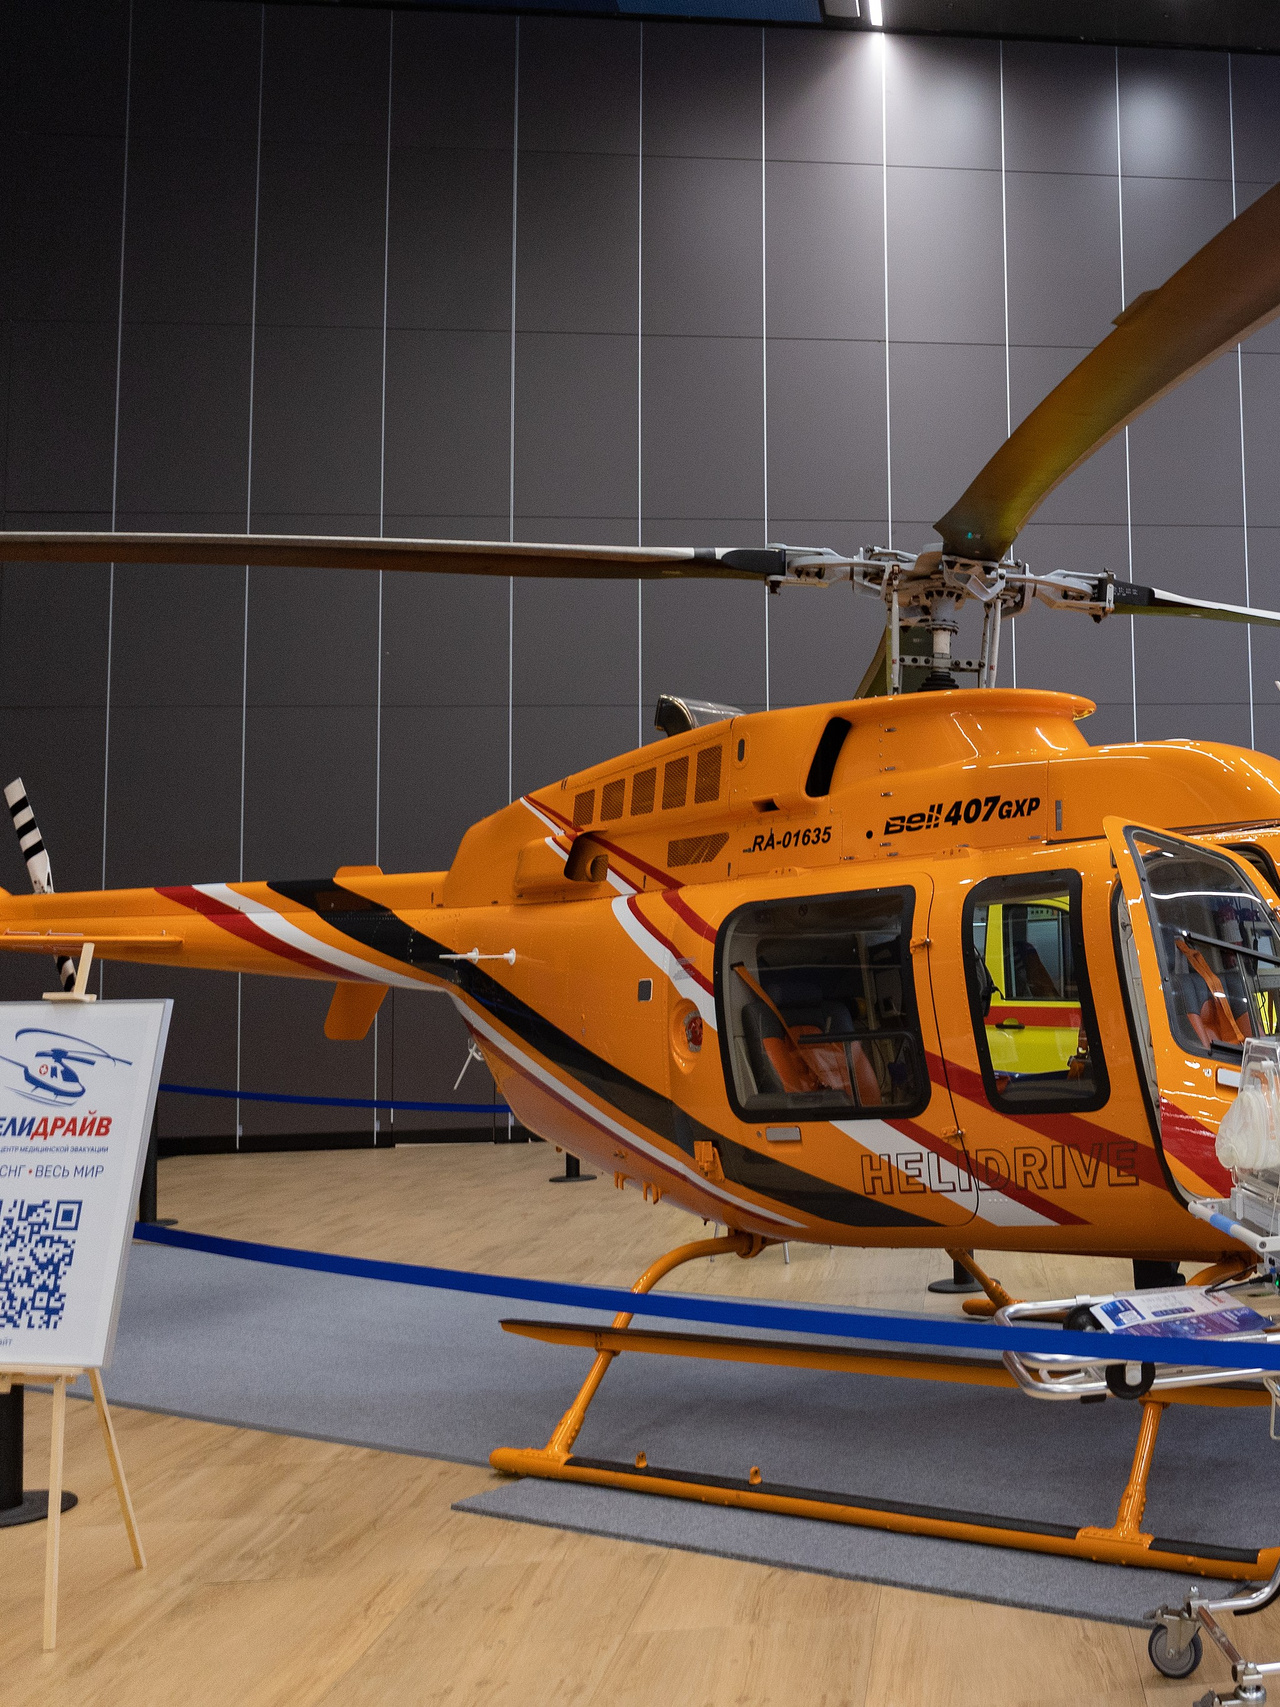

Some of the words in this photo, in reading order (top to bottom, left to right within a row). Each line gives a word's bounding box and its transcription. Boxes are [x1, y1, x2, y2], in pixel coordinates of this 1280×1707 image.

[752, 826, 832, 852] RA-01635
[20, 1145, 69, 1153] МЕДИЦИНСКОЙ
[70, 1145, 108, 1153] ЭВАКУАЦИИ
[0, 1165, 26, 1178] СНГ
[35, 1165, 70, 1178] ВЕСЬ
[74, 1165, 104, 1178] МИР
[860, 1141, 1139, 1195] HELIDRIVE
